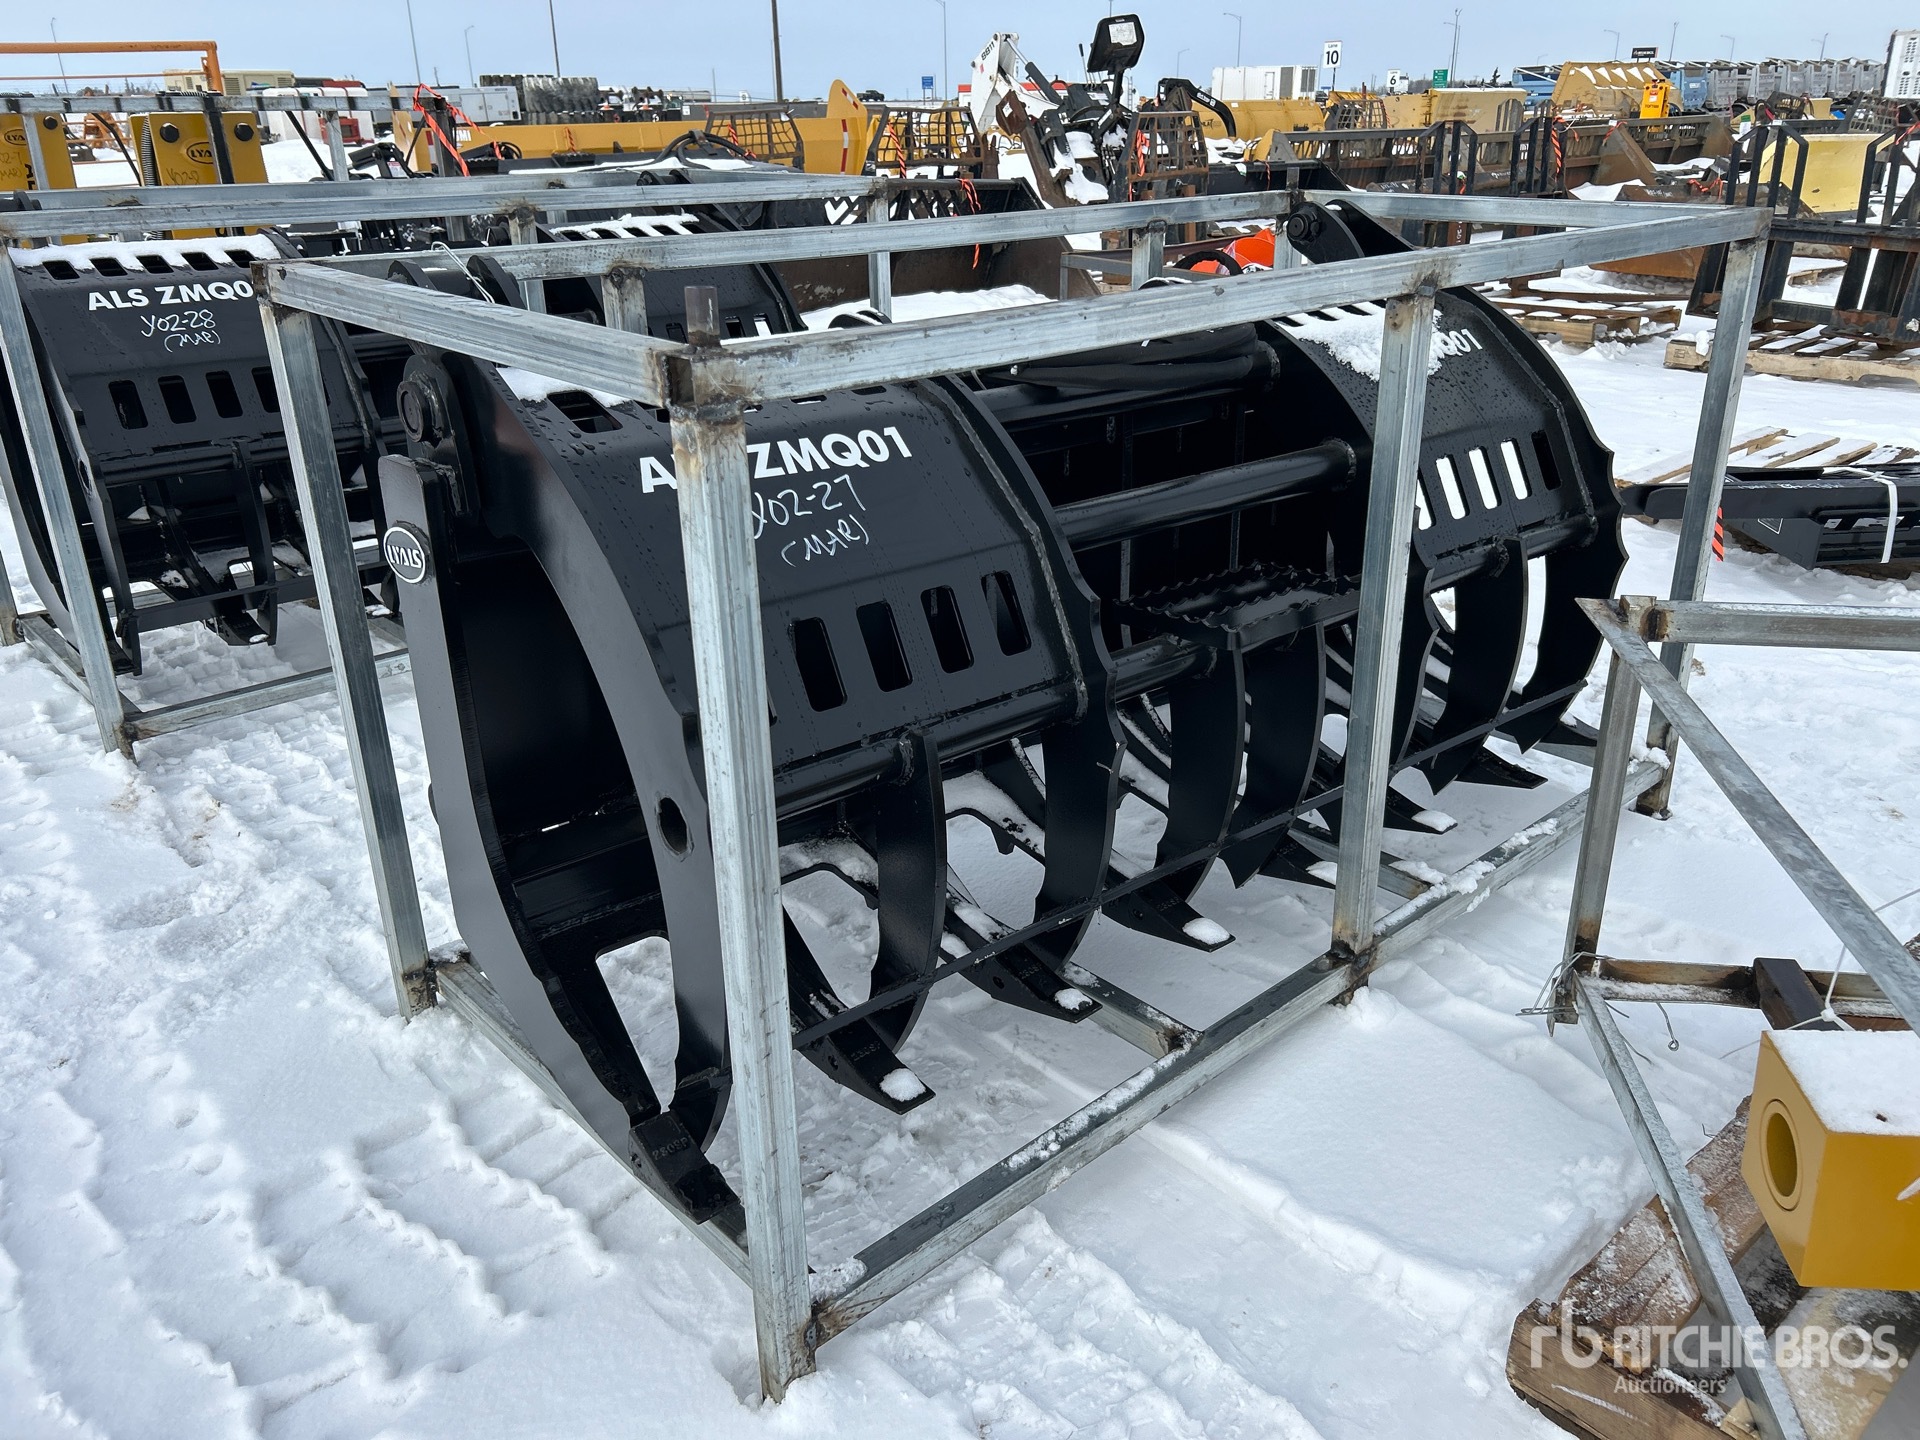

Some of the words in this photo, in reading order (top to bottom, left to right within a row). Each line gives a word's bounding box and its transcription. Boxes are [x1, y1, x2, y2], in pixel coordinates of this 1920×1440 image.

[1326, 50, 1339, 65] 10
[1390, 75, 1396, 85] 6
[190, 149, 212, 157] LYA
[88, 288, 150, 311] ALS
[154, 280, 254, 305] ZMQ0
[746, 426, 912, 479] ZMQ01
